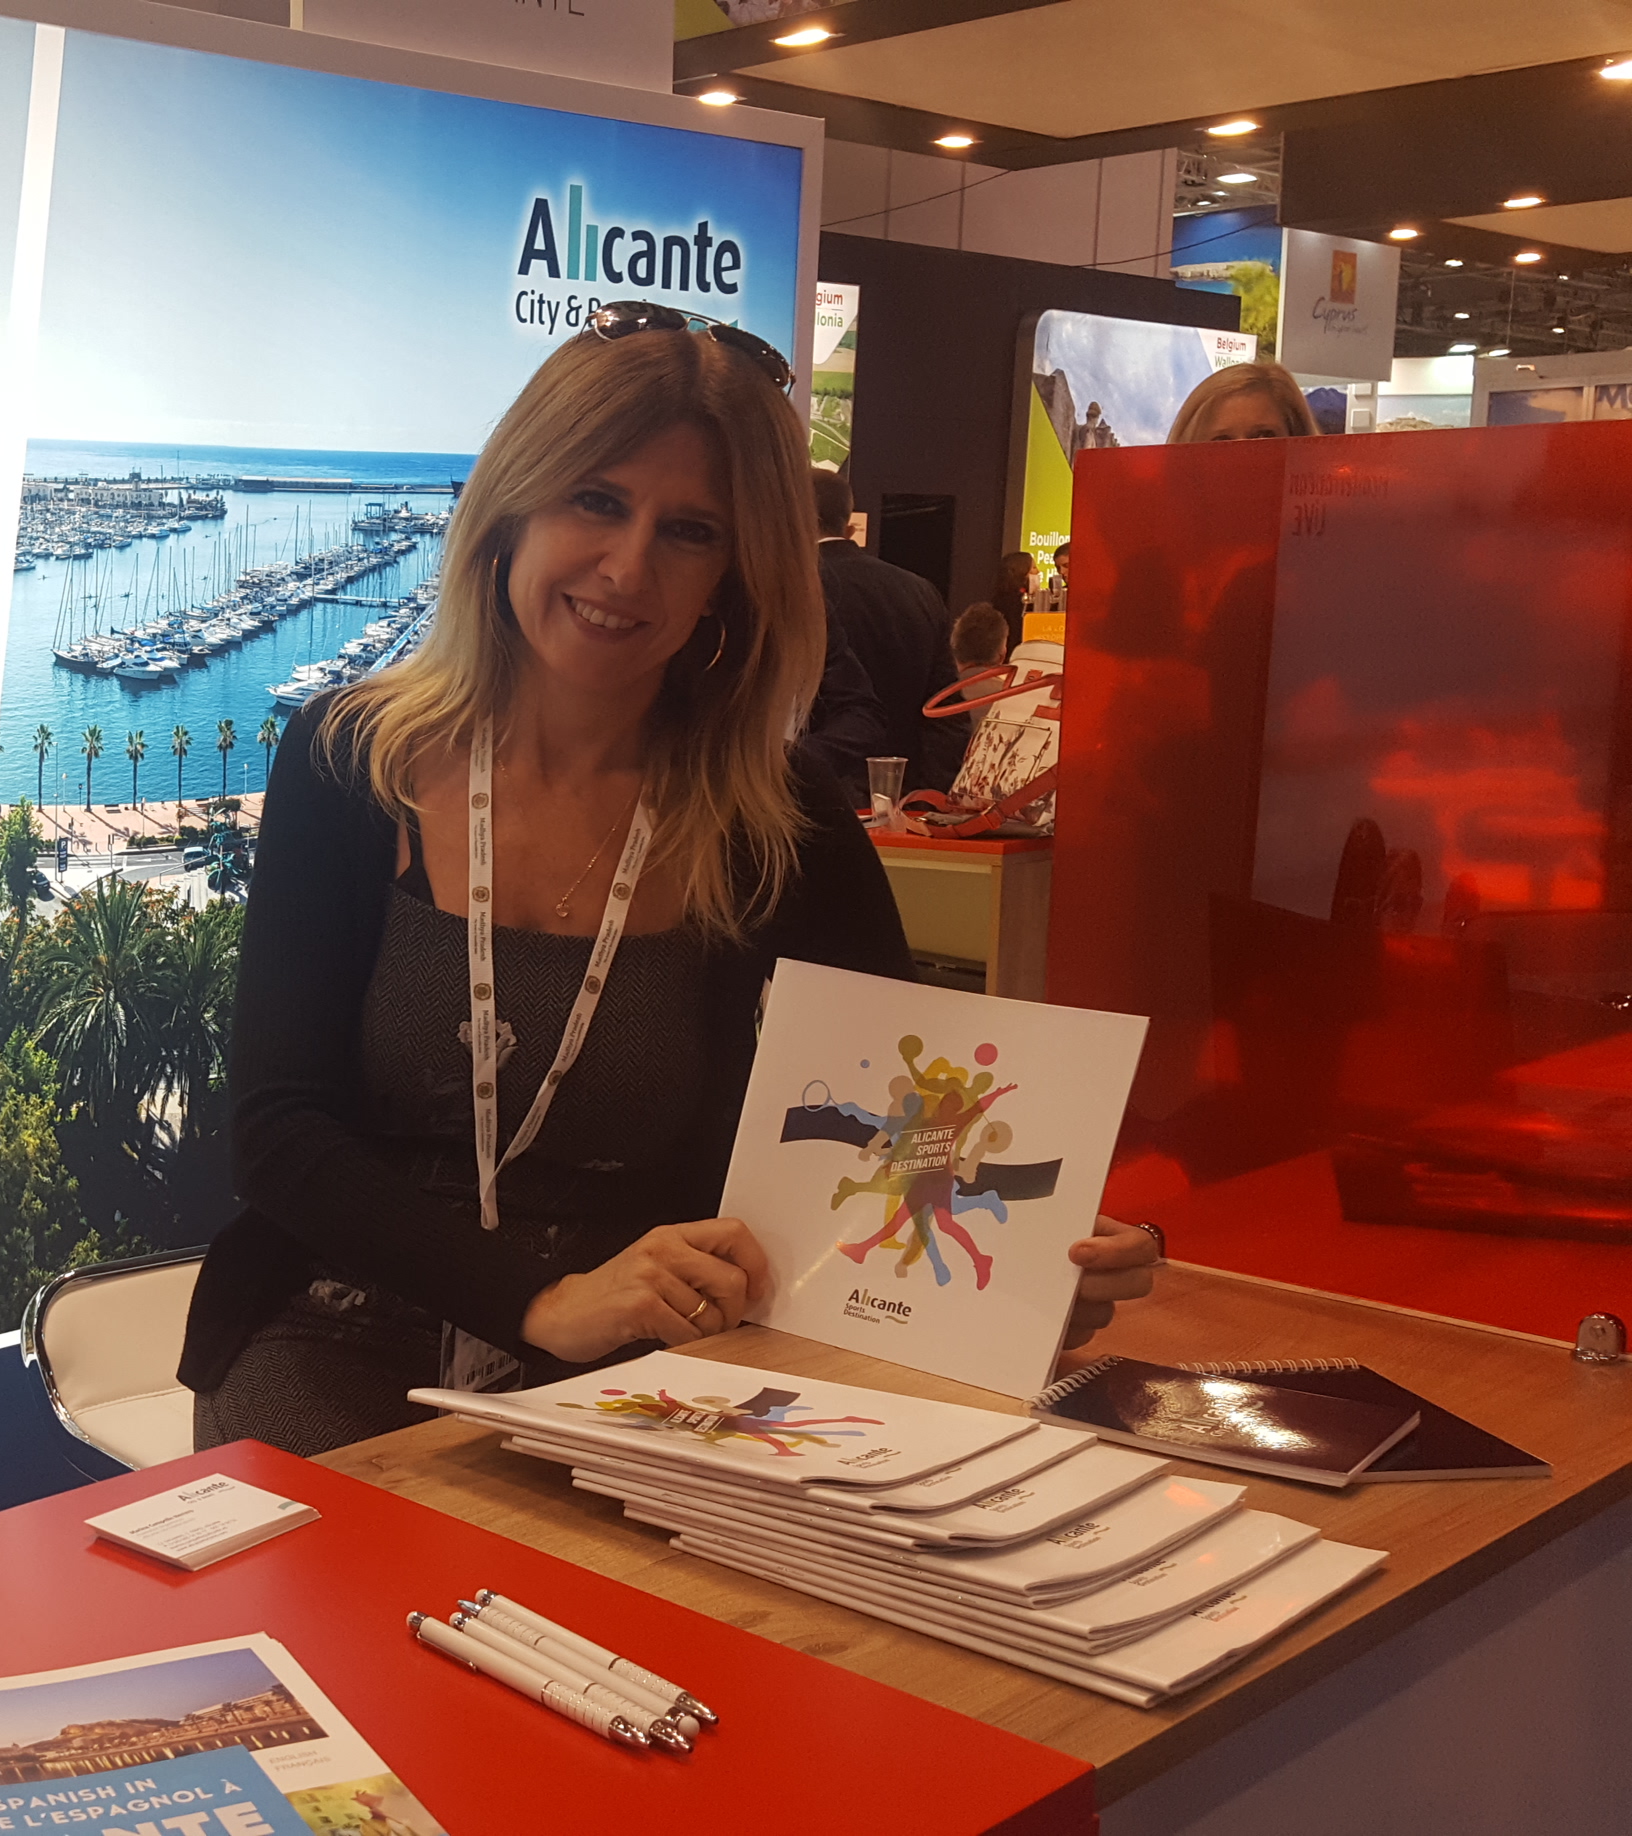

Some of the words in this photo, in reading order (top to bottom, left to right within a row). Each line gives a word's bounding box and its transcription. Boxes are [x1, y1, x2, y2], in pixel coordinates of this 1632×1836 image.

[517, 184, 742, 295] Alicante
[816, 290, 843, 306] gium
[515, 290, 561, 335] City
[565, 295, 583, 328] &
[817, 312, 843, 327] lonia
[1217, 337, 1246, 352] Belgium
[1215, 355, 1245, 368] Wallo
[911, 1128, 955, 1144] ALICANTE
[916, 1142, 952, 1156] SPORTS
[890, 1155, 948, 1172] DESTINATION
[845, 1303, 866, 1314] Sports
[848, 1288, 912, 1317] Alicante
[843, 1309, 881, 1324] Destination
[125, 1778, 157, 1794] IN
[23, 1787, 213, 1827] L'ESPAGNOL
[220, 1779, 242, 1795] À
